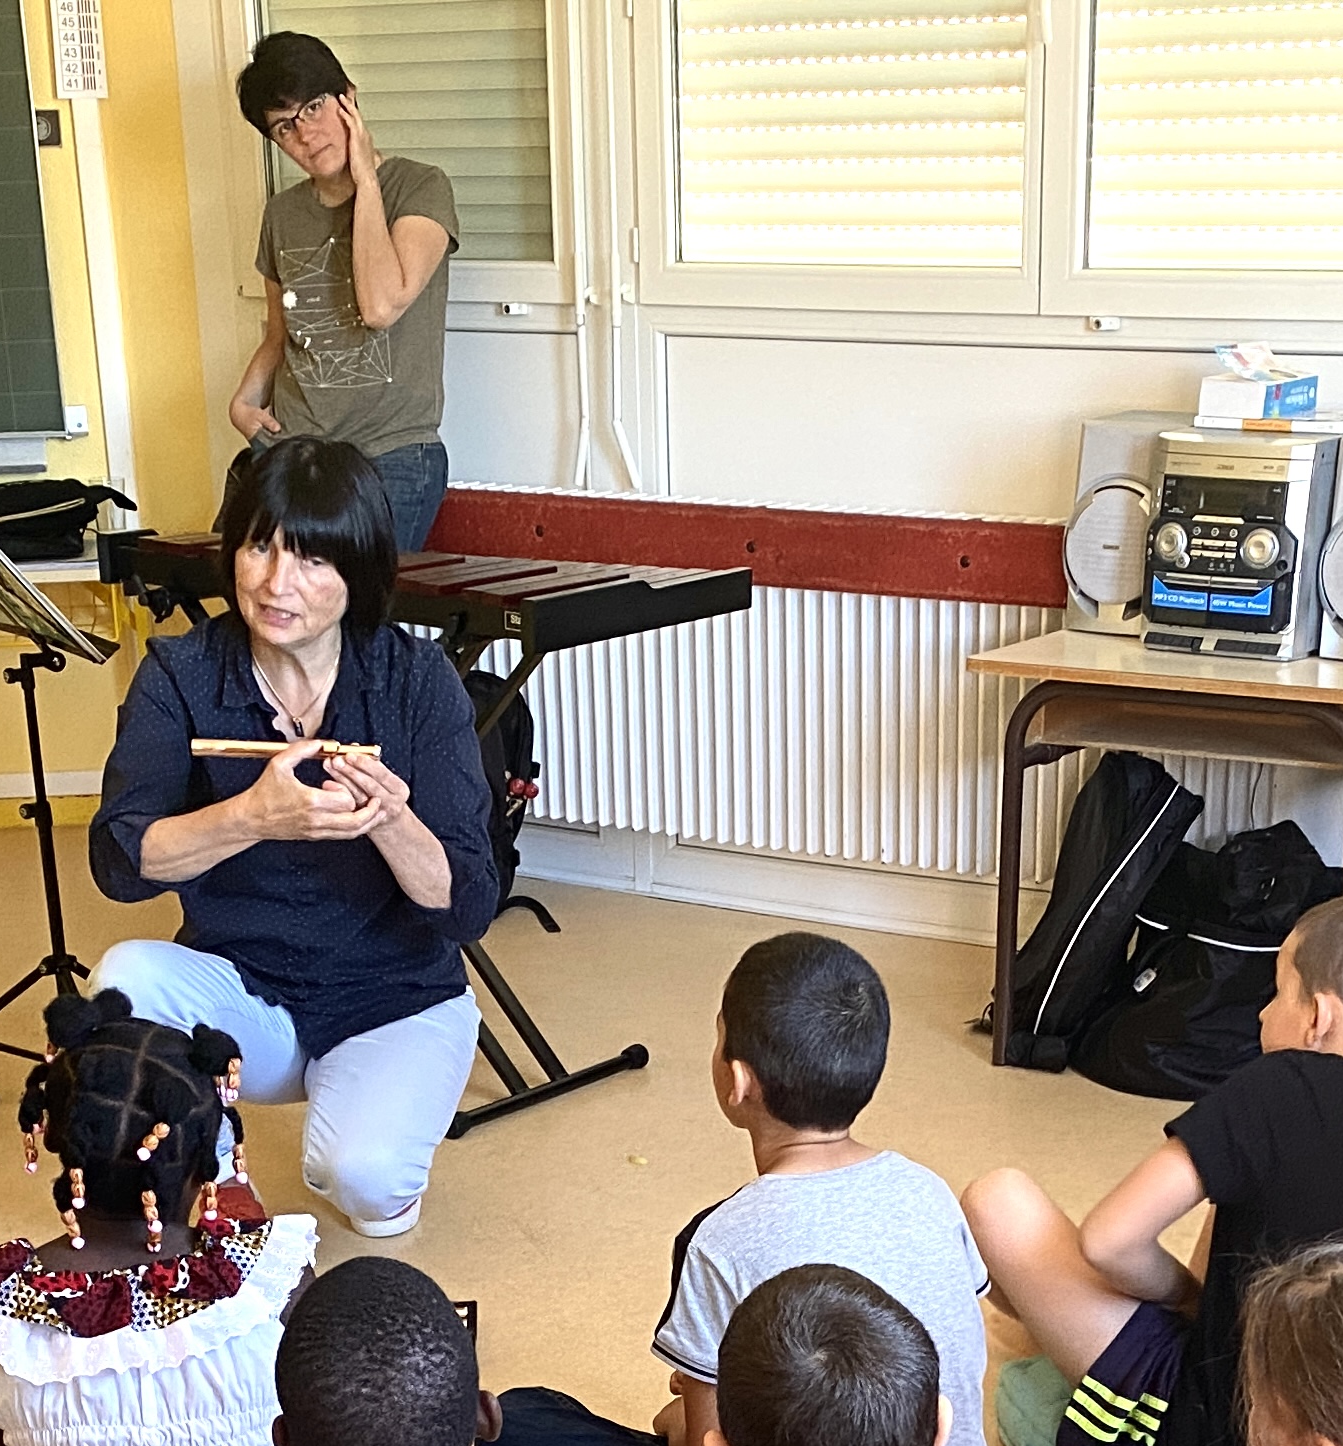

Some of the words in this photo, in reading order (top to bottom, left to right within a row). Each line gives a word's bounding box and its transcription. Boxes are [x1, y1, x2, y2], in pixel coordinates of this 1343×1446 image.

[60, 2, 74, 12] 46
[61, 17, 75, 28] 45
[63, 33, 76, 43] 44
[64, 48, 78, 58] 43
[65, 63, 79, 74] 42
[66, 79, 79, 89] 41
[1168, 594, 1178, 603] CD
